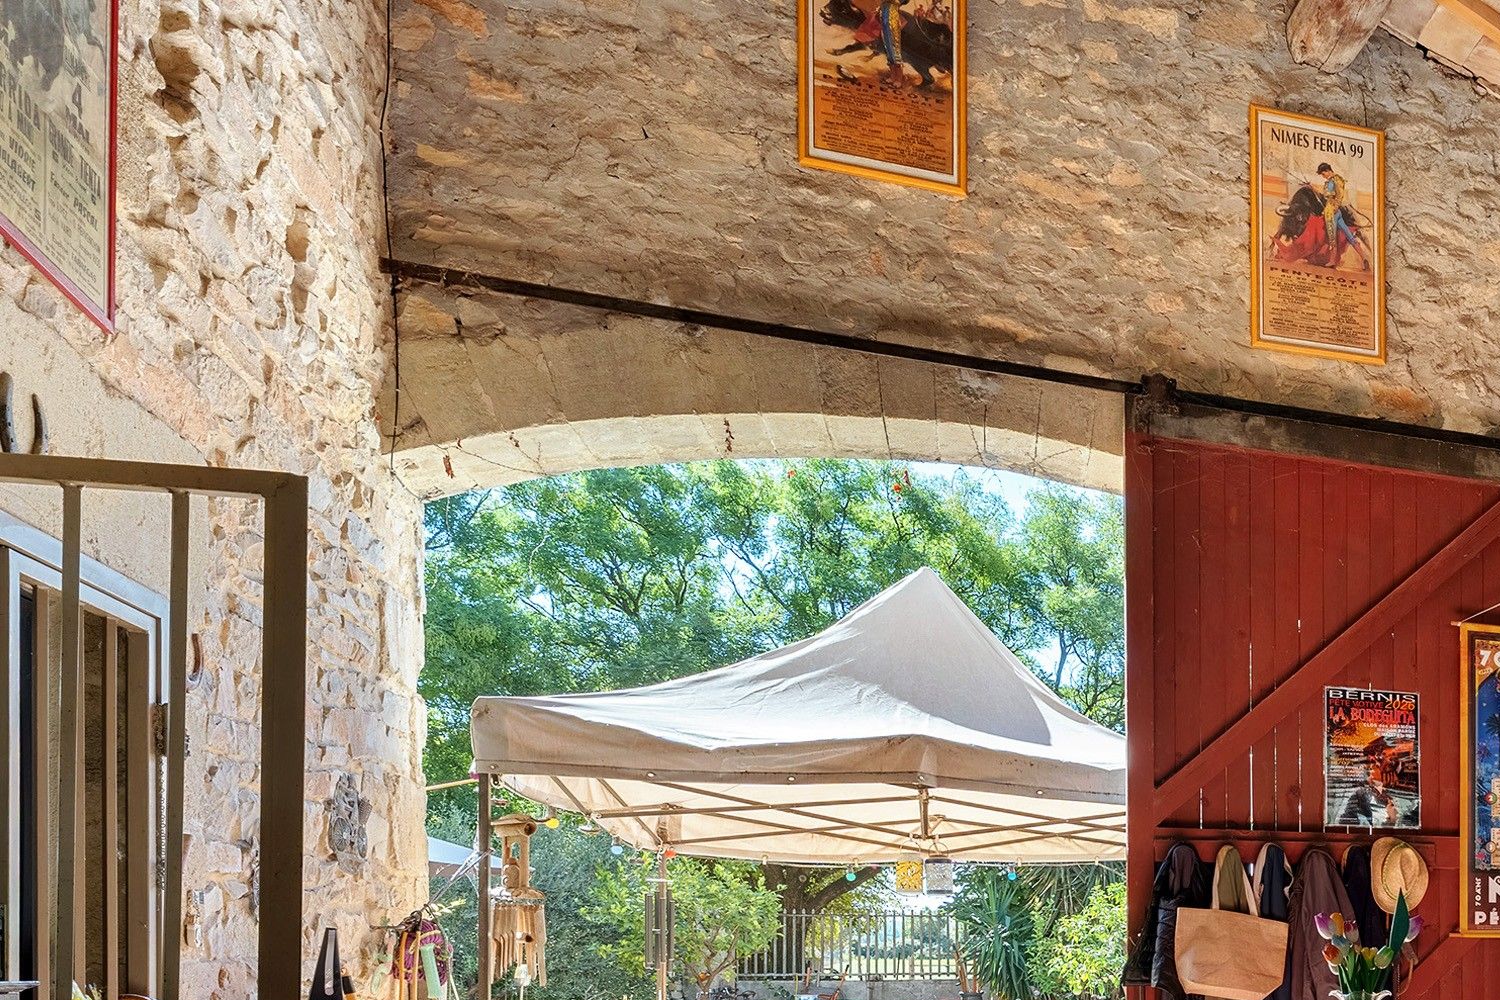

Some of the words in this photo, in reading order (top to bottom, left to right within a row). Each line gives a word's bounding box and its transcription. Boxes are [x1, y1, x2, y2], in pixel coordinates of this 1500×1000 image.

[1271, 128, 1310, 148] NIMES
[1313, 136, 1346, 155] FERIA
[1350, 143, 1364, 158] 99
[1329, 689, 1416, 704] BERNIS
[1352, 700, 1384, 709] VOTIVE
[1329, 706, 1347, 720] LA
[1350, 708, 1416, 724] BODEGUITA
